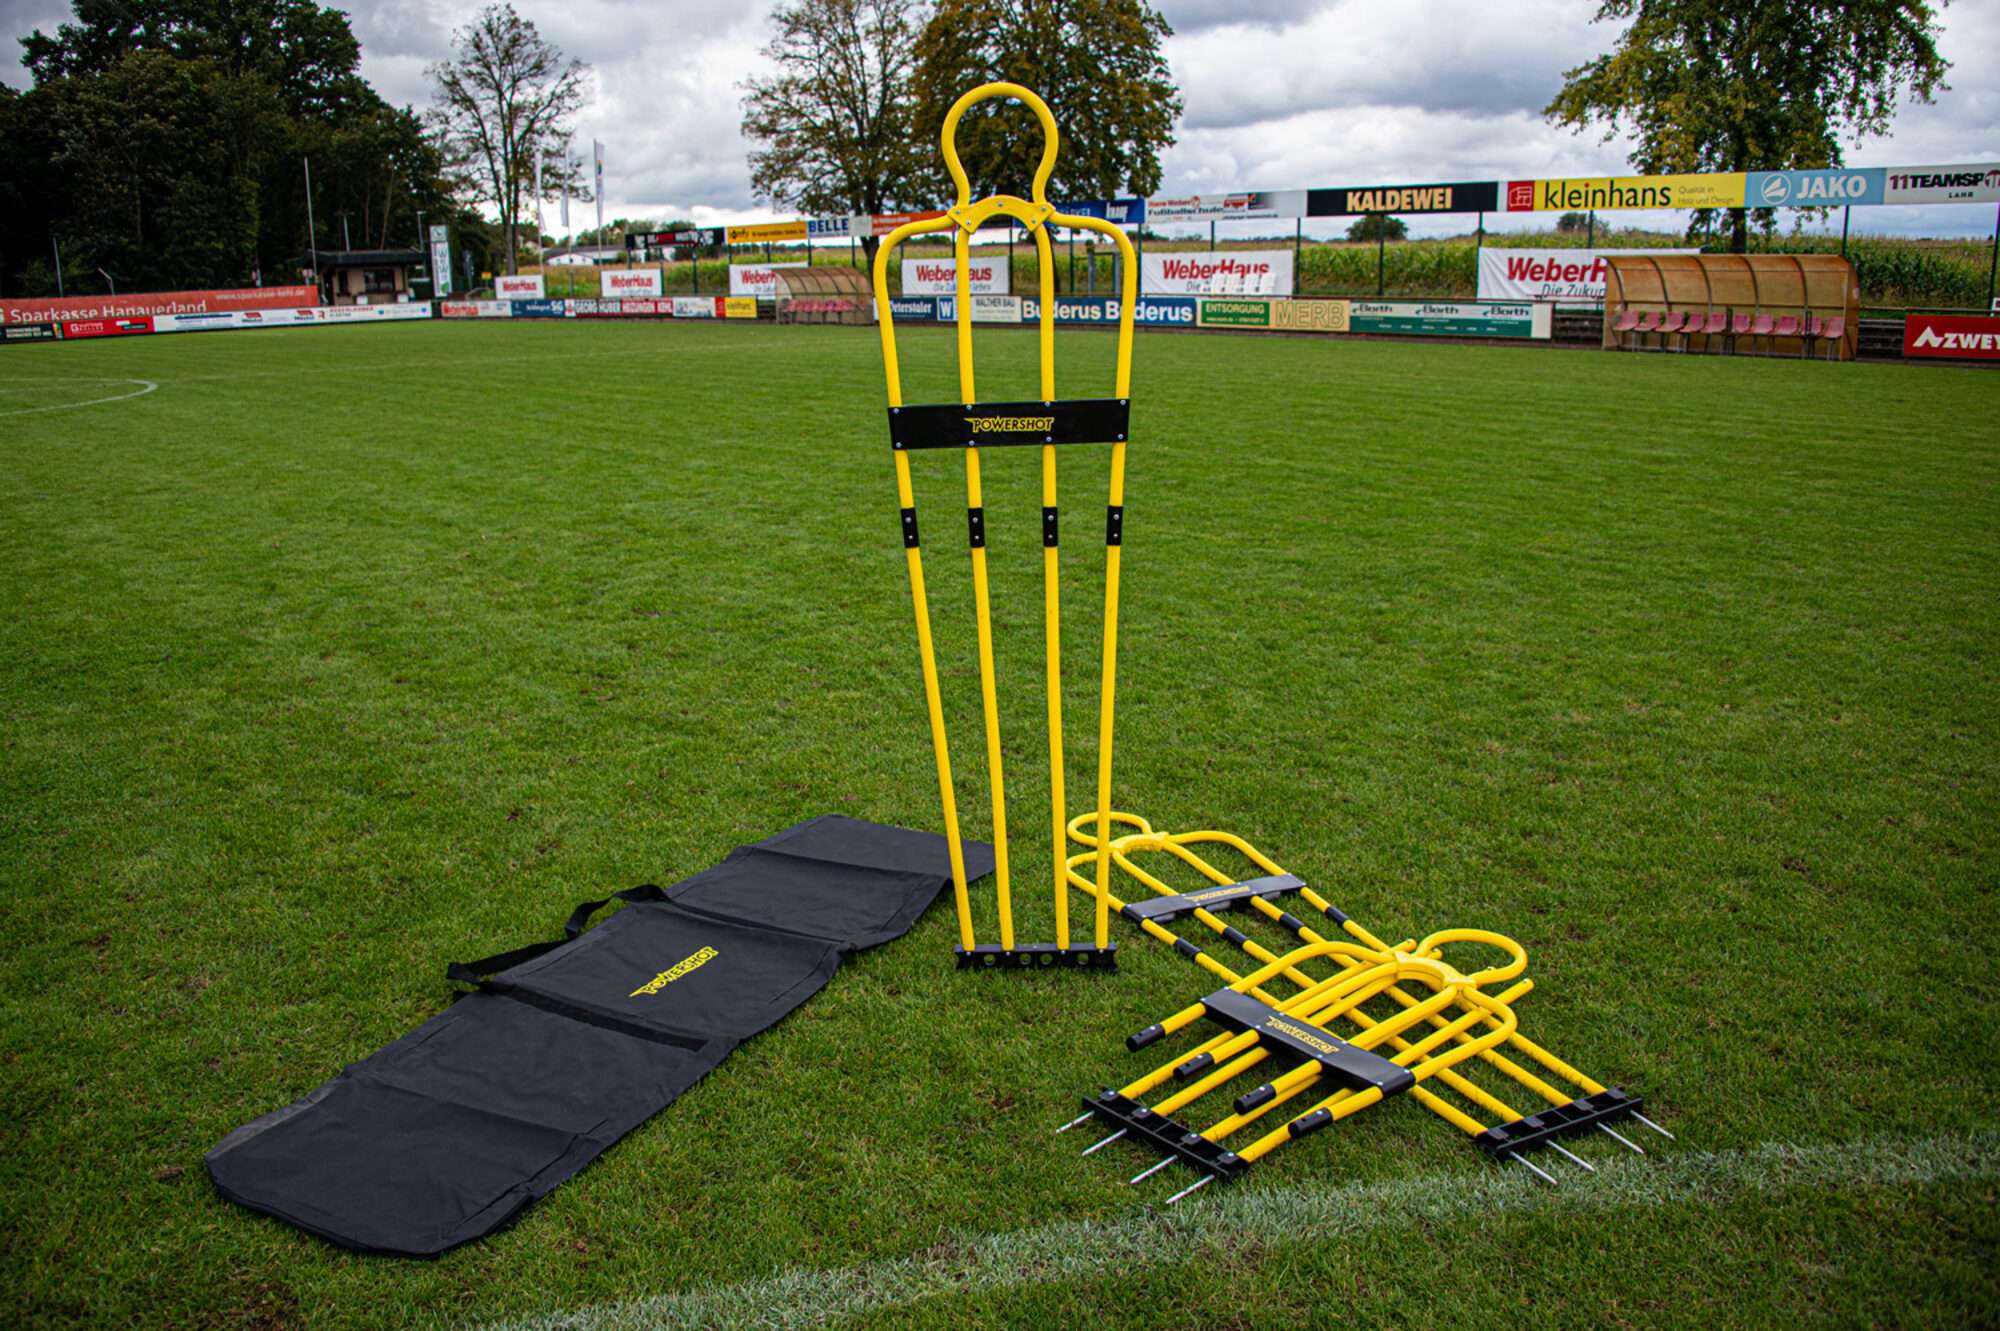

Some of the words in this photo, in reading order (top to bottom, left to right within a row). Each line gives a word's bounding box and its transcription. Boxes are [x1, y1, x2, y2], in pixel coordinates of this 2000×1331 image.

[1544, 179, 1672, 209] kleinhans
[1796, 175, 1867, 199] JAKO
[1346, 187, 1453, 212] KALDEWEI
[809, 217, 848, 233] BELLE
[916, 264, 992, 281] Weberaus
[1541, 284, 1562, 298] Die
[10, 307, 98, 324] Sparkasse
[103, 299, 207, 318] Hanauerland
[940, 302, 952, 317] W
[1106, 301, 1193, 321] Bderus
[1206, 303, 1265, 314] ENTSORGUNG
[1276, 301, 1344, 329] MERB
[963, 416, 1055, 433] POWERSHOT
[628, 945, 720, 998] POWERSHOT
[1266, 1015, 1341, 1055] POWERSHOT
